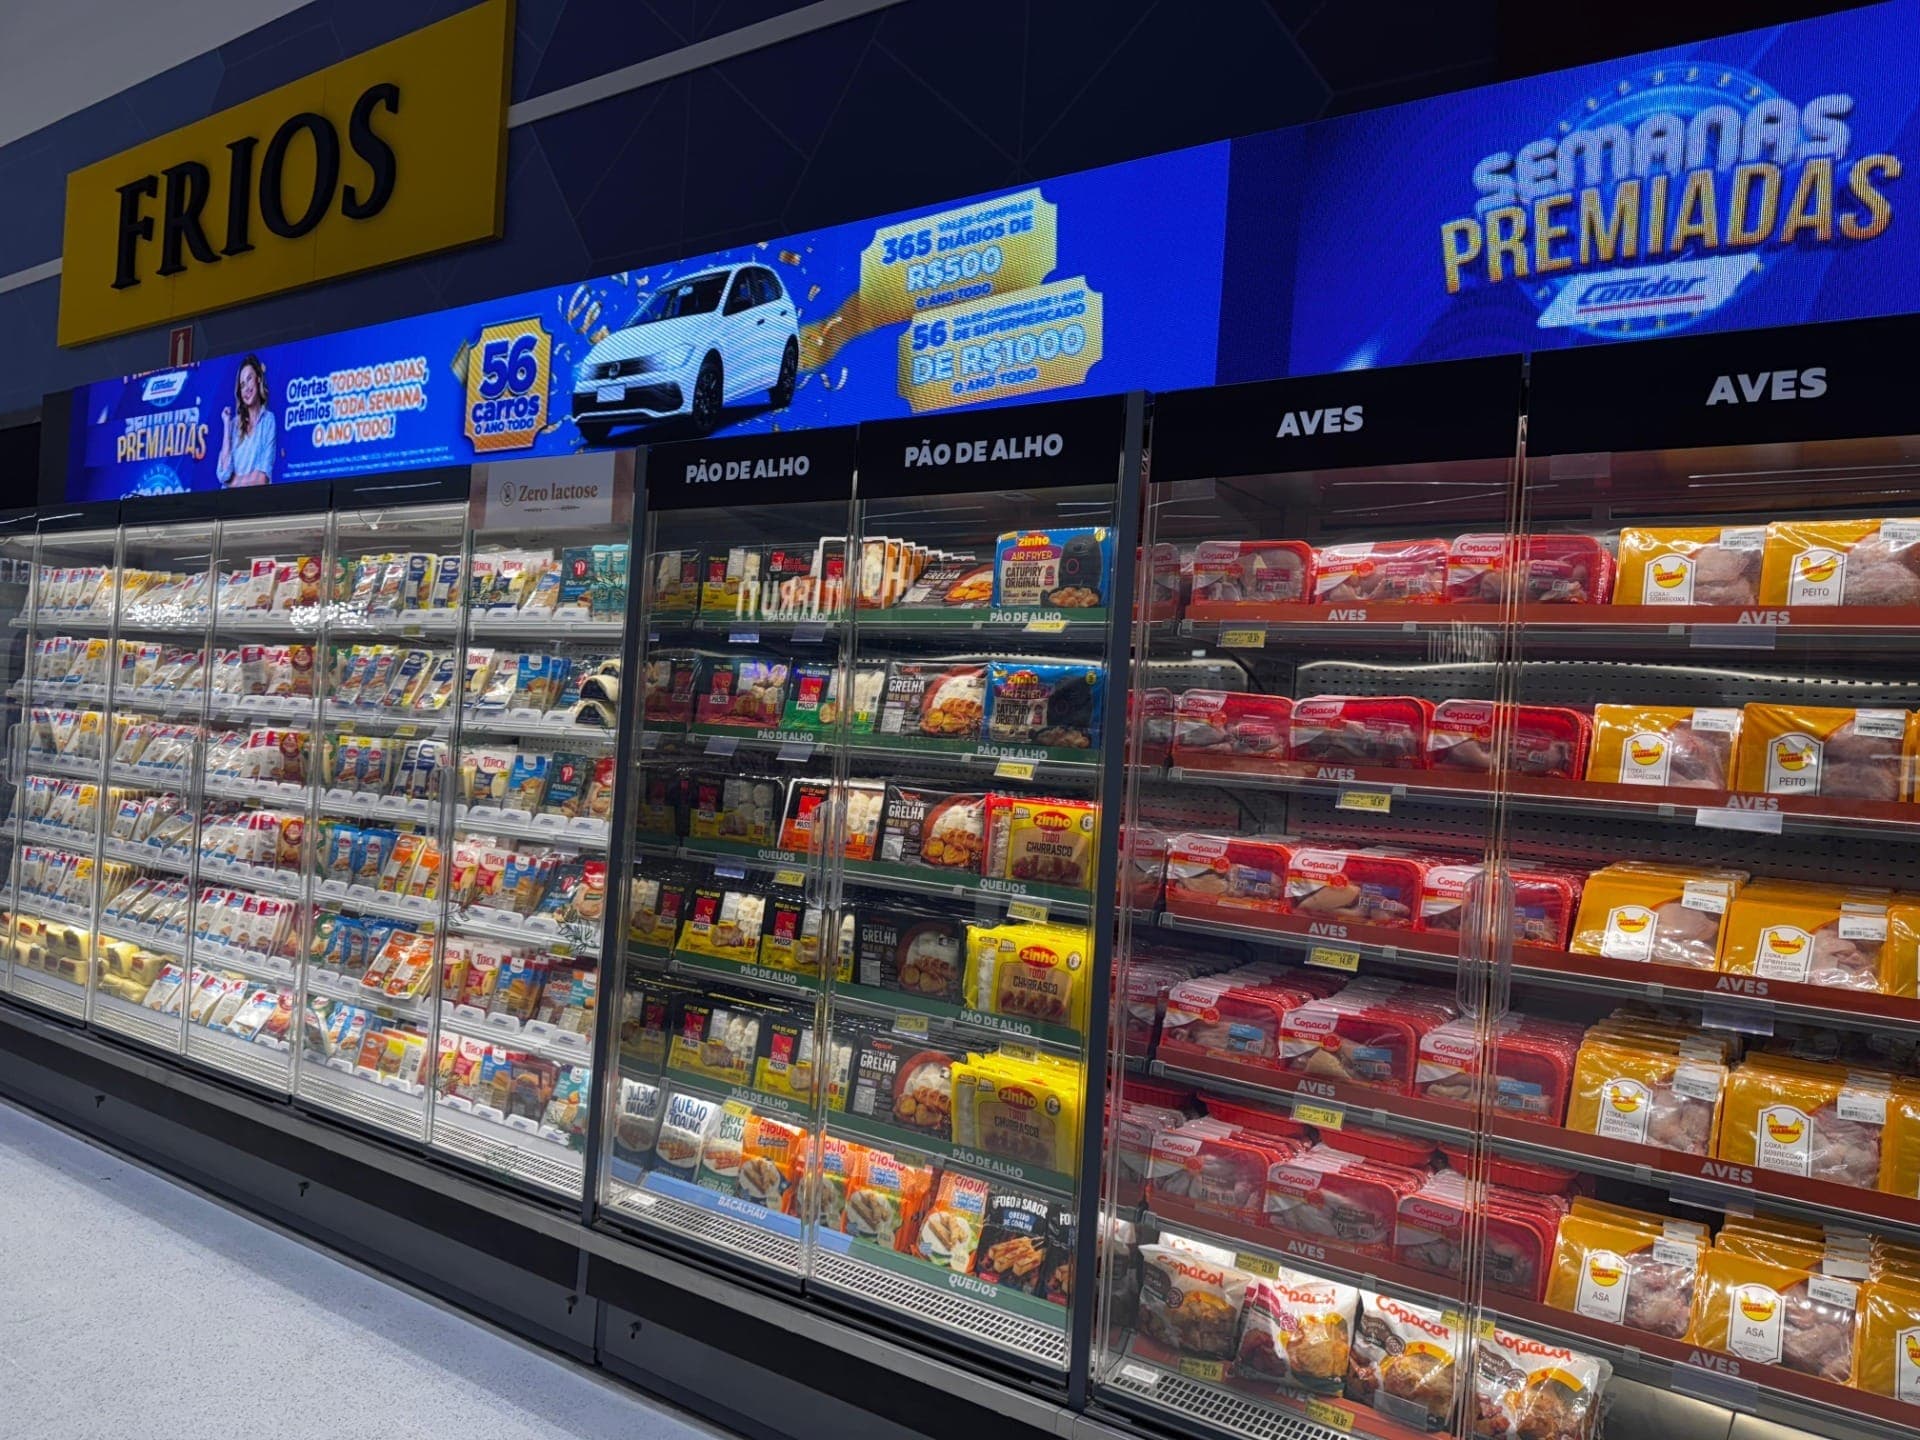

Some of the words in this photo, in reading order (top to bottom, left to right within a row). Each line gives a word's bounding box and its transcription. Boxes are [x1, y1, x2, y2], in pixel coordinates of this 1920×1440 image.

[1472, 93, 1855, 214] SEMANAS
[110, 82, 400, 290] FRIOS
[1440, 154, 1903, 294] PREMIADAS
[937, 222, 1005, 253] DIÁRIOS
[1008, 215, 1034, 237] DE
[880, 229, 932, 266] 365
[907, 245, 1004, 292] R$500
[916, 297, 927, 309] O
[928, 292, 954, 306] ANO
[957, 283, 992, 300] TODO
[973, 303, 1086, 336] SUPERMERCADO
[913, 320, 948, 351] 56
[911, 350, 955, 386] DE
[960, 324, 1086, 376] R$1000
[479, 334, 539, 399] 56
[287, 377, 329, 400] Ofertas
[331, 369, 372, 391] TODOS
[373, 365, 391, 385] OS
[952, 381, 964, 394] O
[966, 375, 996, 391] ANO
[999, 368, 1038, 384] TODO
[1705, 367, 1828, 406] AVES
[286, 403, 331, 428] prêmios
[333, 395, 367, 417] TODA
[368, 387, 426, 411] SEMANA,
[471, 395, 541, 423] carros
[313, 426, 325, 445] O
[326, 421, 353, 442] ANO
[355, 416, 395, 439] TODO!
[474, 424, 483, 435] O
[484, 420, 505, 434] ANO
[507, 418, 535, 431] TODO
[1275, 405, 1364, 438] AVES
[116, 421, 209, 464] PREMIADAS
[904, 439, 951, 468] PÃO
[954, 442, 986, 464] DE
[989, 432, 1064, 462] ALHO
[685, 458, 722, 484] PÃO
[724, 460, 751, 481] DE
[752, 455, 811, 479] ALHO
[518, 484, 548, 502] Zero
[551, 482, 599, 501] lactose
[1017, 535, 1051, 547] zinho
[1010, 551, 1026, 561] AIR
[1026, 550, 1054, 561] FRYER
[1005, 565, 1043, 578] CATUPIRY
[1004, 577, 1041, 589] ORIGINAL
[1801, 586, 1830, 598] PEITO
[990, 609, 1012, 622] PÃO
[1014, 611, 1030, 622] DE
[1031, 611, 1062, 623] ALHO
[1328, 609, 1367, 622] AVES
[1736, 610, 1791, 625] AVES
[888, 679, 925, 693] GRELHA
[1300, 705, 1338, 716] Copacol
[1443, 709, 1486, 722] Copacol
[757, 729, 775, 740] PÃO
[776, 731, 788, 741] DE
[788, 731, 814, 743] ALHO
[1444, 724, 1473, 732] CORTES
[977, 744, 999, 757] PÃO
[1000, 747, 1016, 758] DE
[1016, 748, 1048, 761] ALHO
[1316, 766, 1356, 780] AVES
[1778, 776, 1807, 788] PEITO
[1726, 795, 1779, 811] AVES
[888, 804, 925, 821] GRELHA
[1035, 814, 1071, 829] zinho
[757, 849, 796, 863] QUEIJOS
[1026, 841, 1073, 857] CHURRASCO
[1187, 841, 1223, 855] Copacol
[1301, 858, 1340, 872] Copacol
[979, 878, 1027, 895] QUEIJOS
[861, 929, 898, 947] GRELHA
[1308, 922, 1348, 938] AVES
[1022, 948, 1058, 965] zinho
[740, 964, 758, 979] PÃO
[758, 969, 771, 981] DE
[771, 971, 797, 985] ALHO
[1012, 976, 1058, 994] CHURRASCO
[1715, 975, 1769, 996] AVES
[1178, 990, 1214, 1006] Copacol
[960, 1009, 983, 1026] PÃO
[983, 1014, 999, 1028] DE
[998, 1017, 1032, 1036] ALHO
[1293, 1016, 1332, 1031] Copacol
[860, 1053, 898, 1075] GRELHA
[1433, 1054, 1462, 1066] CORTES
[1297, 1079, 1336, 1097] AVES
[731, 1086, 751, 1101] PÃO
[751, 1091, 765, 1103] DE
[764, 1094, 790, 1111] ALHO
[1001, 1087, 1036, 1108] zinho
[1161, 1137, 1195, 1154] Copacol
[952, 1147, 975, 1166] PÃO
[975, 1156, 991, 1171] DE
[990, 1160, 1024, 1179] ALHO
[1701, 1159, 1753, 1184] AVES
[1277, 1170, 1316, 1187] Copacol
[718, 1195, 769, 1221] BACALHAU
[1021, 1198, 1049, 1219] SABOR
[1287, 1239, 1326, 1260] AVES
[948, 1273, 998, 1299] QUEIJOS
[1592, 1289, 1611, 1305] ASA
[1375, 1293, 1451, 1340] Copacol
[1745, 1326, 1765, 1340] ASA
[1688, 1350, 1742, 1376] AVES
